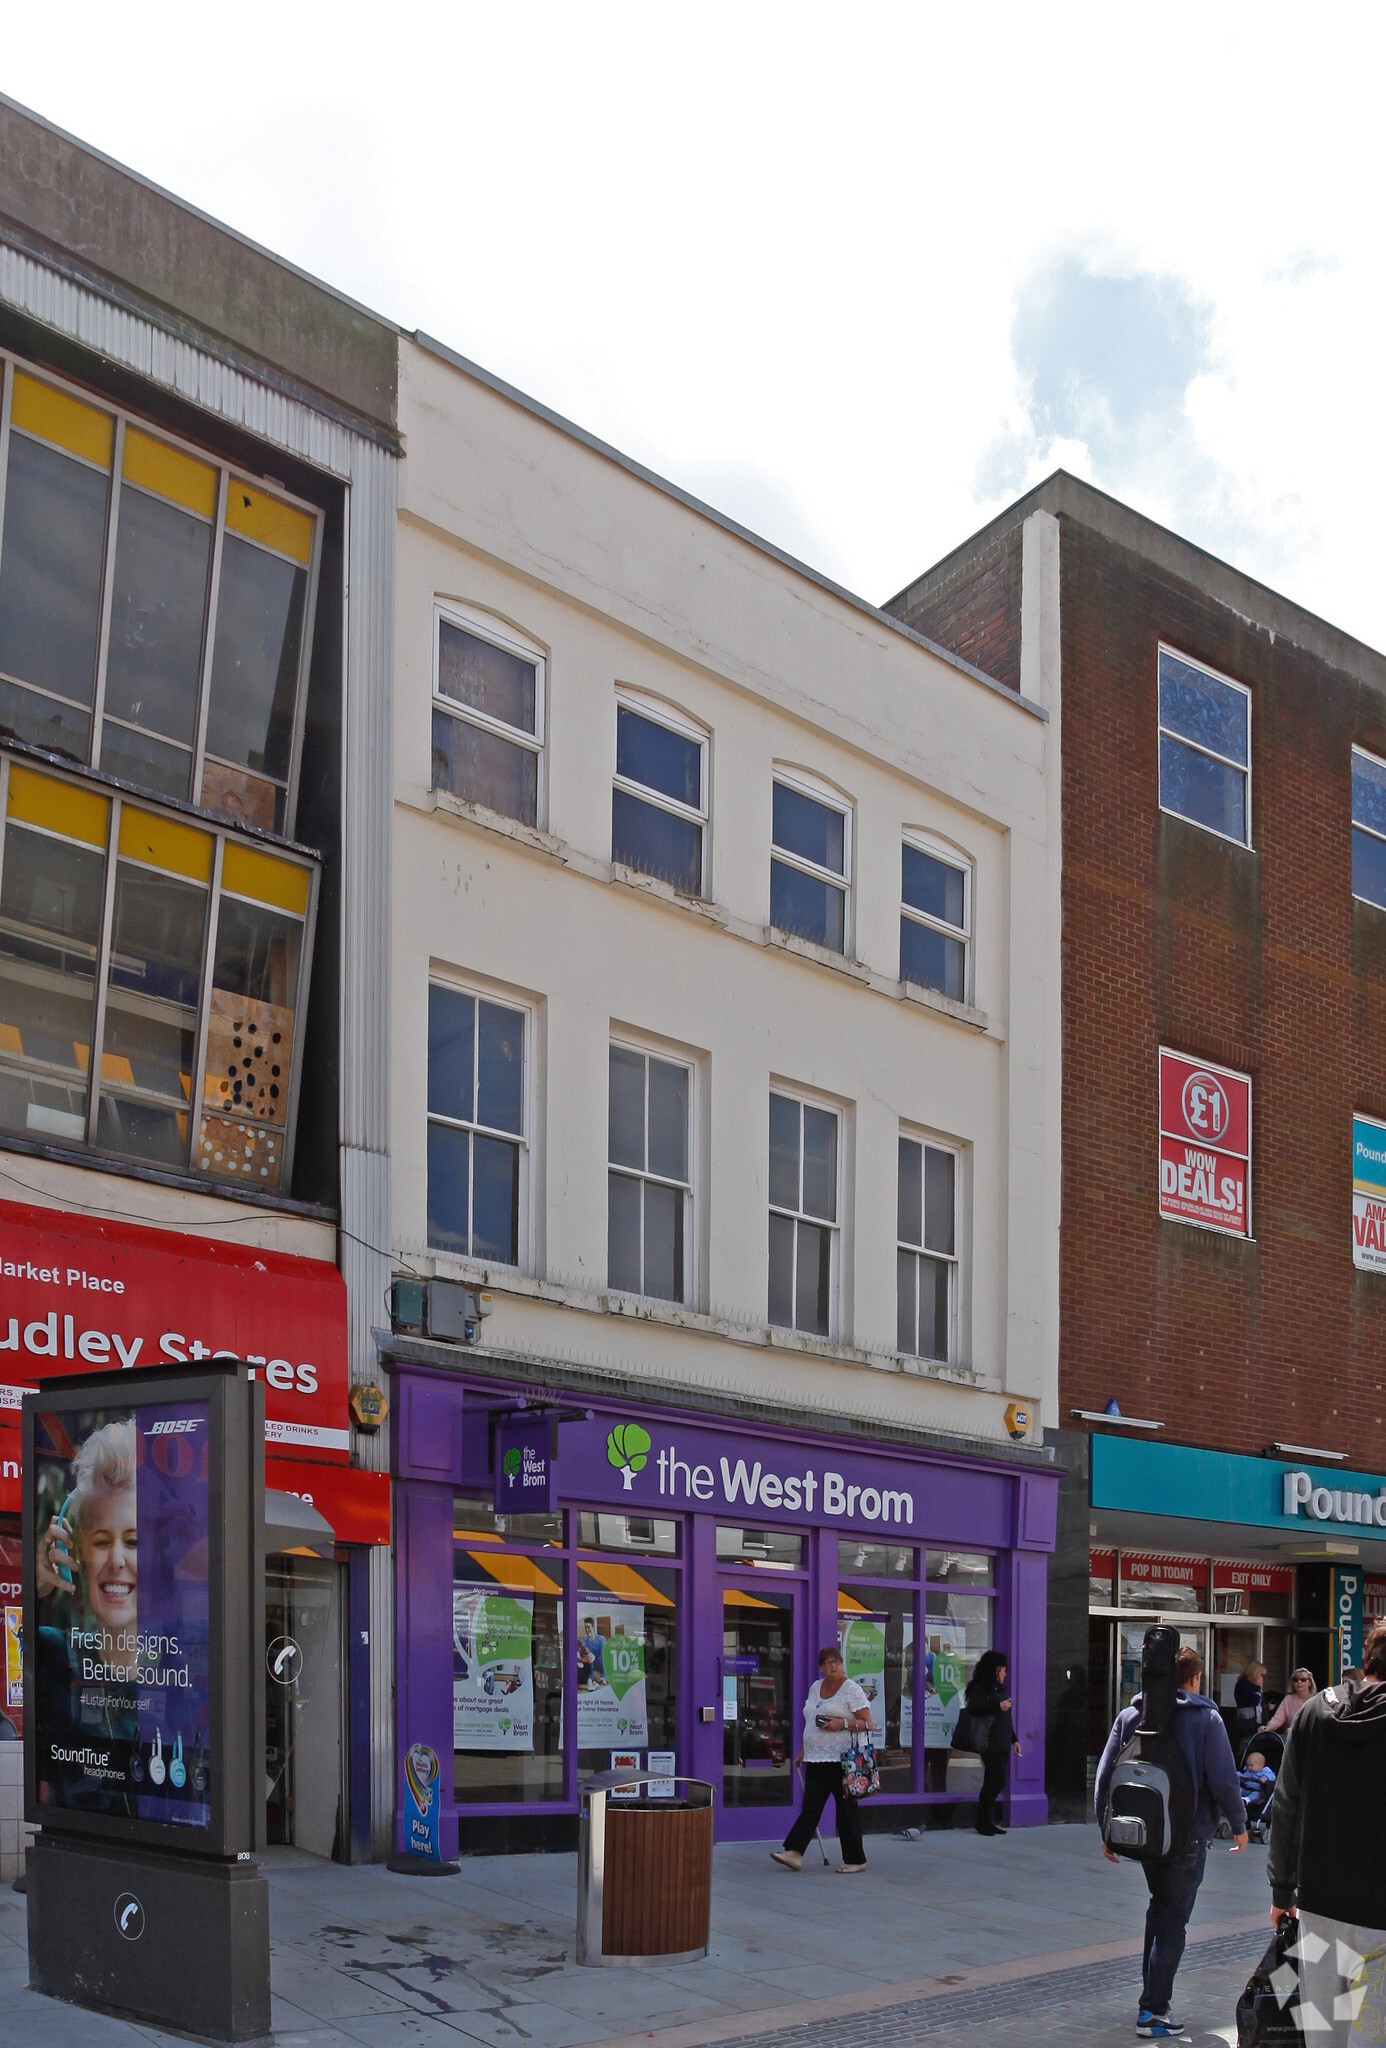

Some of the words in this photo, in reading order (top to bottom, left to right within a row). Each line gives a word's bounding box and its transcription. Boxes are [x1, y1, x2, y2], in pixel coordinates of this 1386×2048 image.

[1190, 1085, 1221, 1132] £1
[1184, 1148, 1217, 1173] WOW
[1161, 1159, 1243, 1214] DEALS!
[0, 1256, 59, 1284] arket
[67, 1268, 125, 1295] Place
[159, 1332, 319, 1394] Stres
[144, 1418, 205, 1435] BOSE
[286, 1425, 319, 1436] DRINKS
[523, 1446, 535, 1460] the
[523, 1459, 545, 1473] West
[523, 1473, 546, 1487] Brom
[656, 1446, 715, 1500] the
[719, 1456, 818, 1513] West
[823, 1471, 914, 1525] Brom
[1131, 1563, 1150, 1577] POP
[1151, 1565, 1161, 1578] IN
[1163, 1566, 1194, 1581] TODAY!
[1231, 1572, 1250, 1585] EXIT
[1251, 1574, 1272, 1587] ONLY
[70, 1626, 113, 1651] Fresh
[117, 1628, 183, 1661] designs.
[82, 1657, 132, 1683] Better
[136, 1664, 194, 1688] sound.
[80, 1694, 151, 1710] #ListenForYourself
[84, 1765, 126, 1781] headphones
[412, 1819, 430, 1839] Play
[410, 1836, 432, 1854] here!
